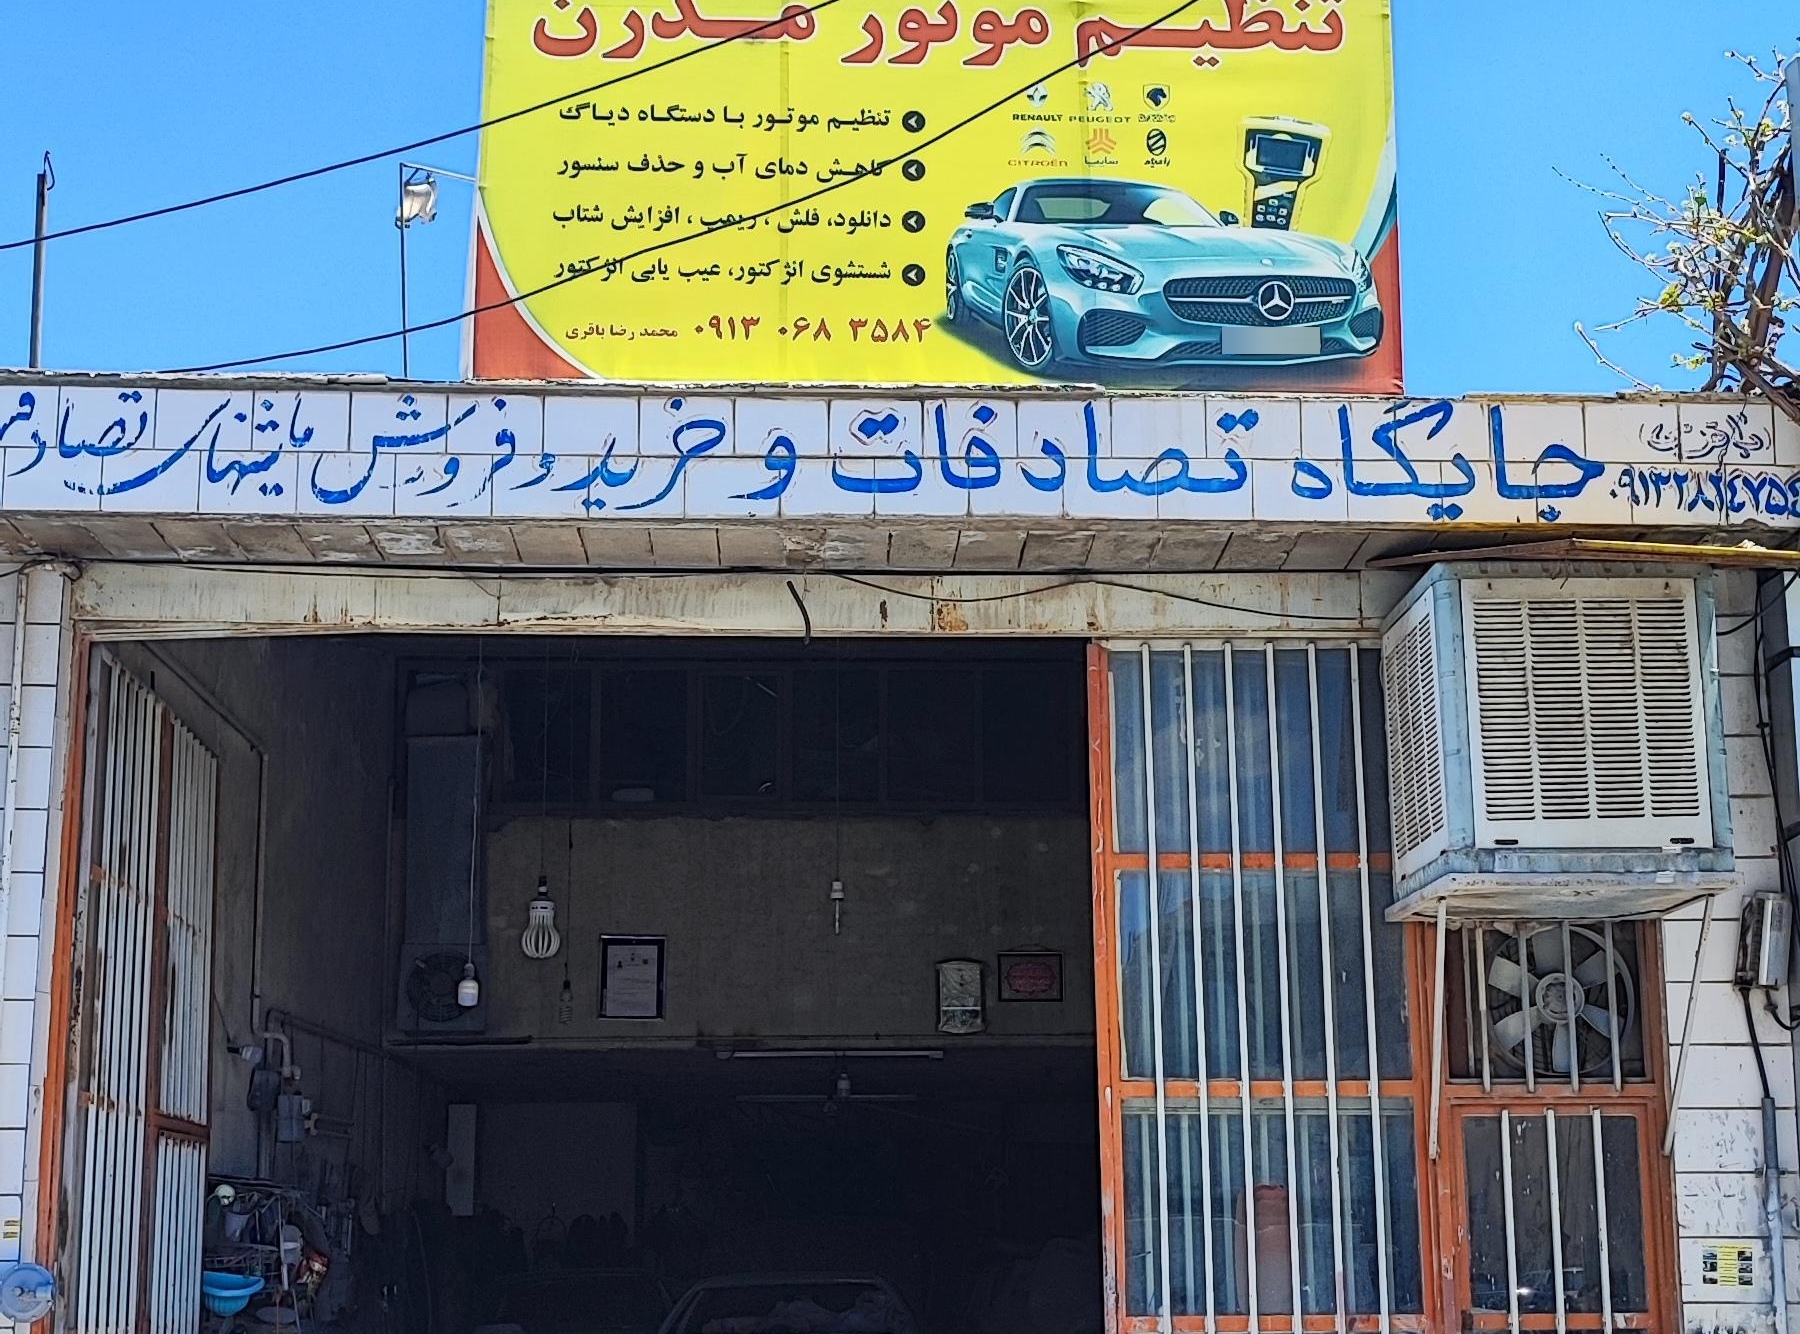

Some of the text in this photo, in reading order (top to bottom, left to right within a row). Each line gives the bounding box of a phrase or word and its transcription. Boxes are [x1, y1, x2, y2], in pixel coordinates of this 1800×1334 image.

[559, 101, 891, 132] تنظیم موتور با دستگاه دیاگ
[1012, 113, 1063, 122] RENAULT
[1068, 115, 1132, 124] PEUGEOT
[556, 153, 894, 183] کاهش دمای آب و حذف سنسور
[552, 204, 604, 229] شتاب
[611, 205, 680, 231] افزایش
[827, 210, 892, 235] دانلود،
[553, 255, 625, 282] انژکتور
[631, 258, 670, 282] یابی
[678, 264, 721, 282] عیب
[811, 260, 891, 286] شستشوی
[565, 323, 679, 340] محمد رضا باقری
[694, 315, 931, 343] ۰۹۱۳ ۰۶۸ ۳۵۸۴
[551, 398, 726, 510] خرید
[832, 402, 1258, 495] تصادفات
[1290, 400, 1606, 521] جایگاه
[728, 435, 797, 499] و
